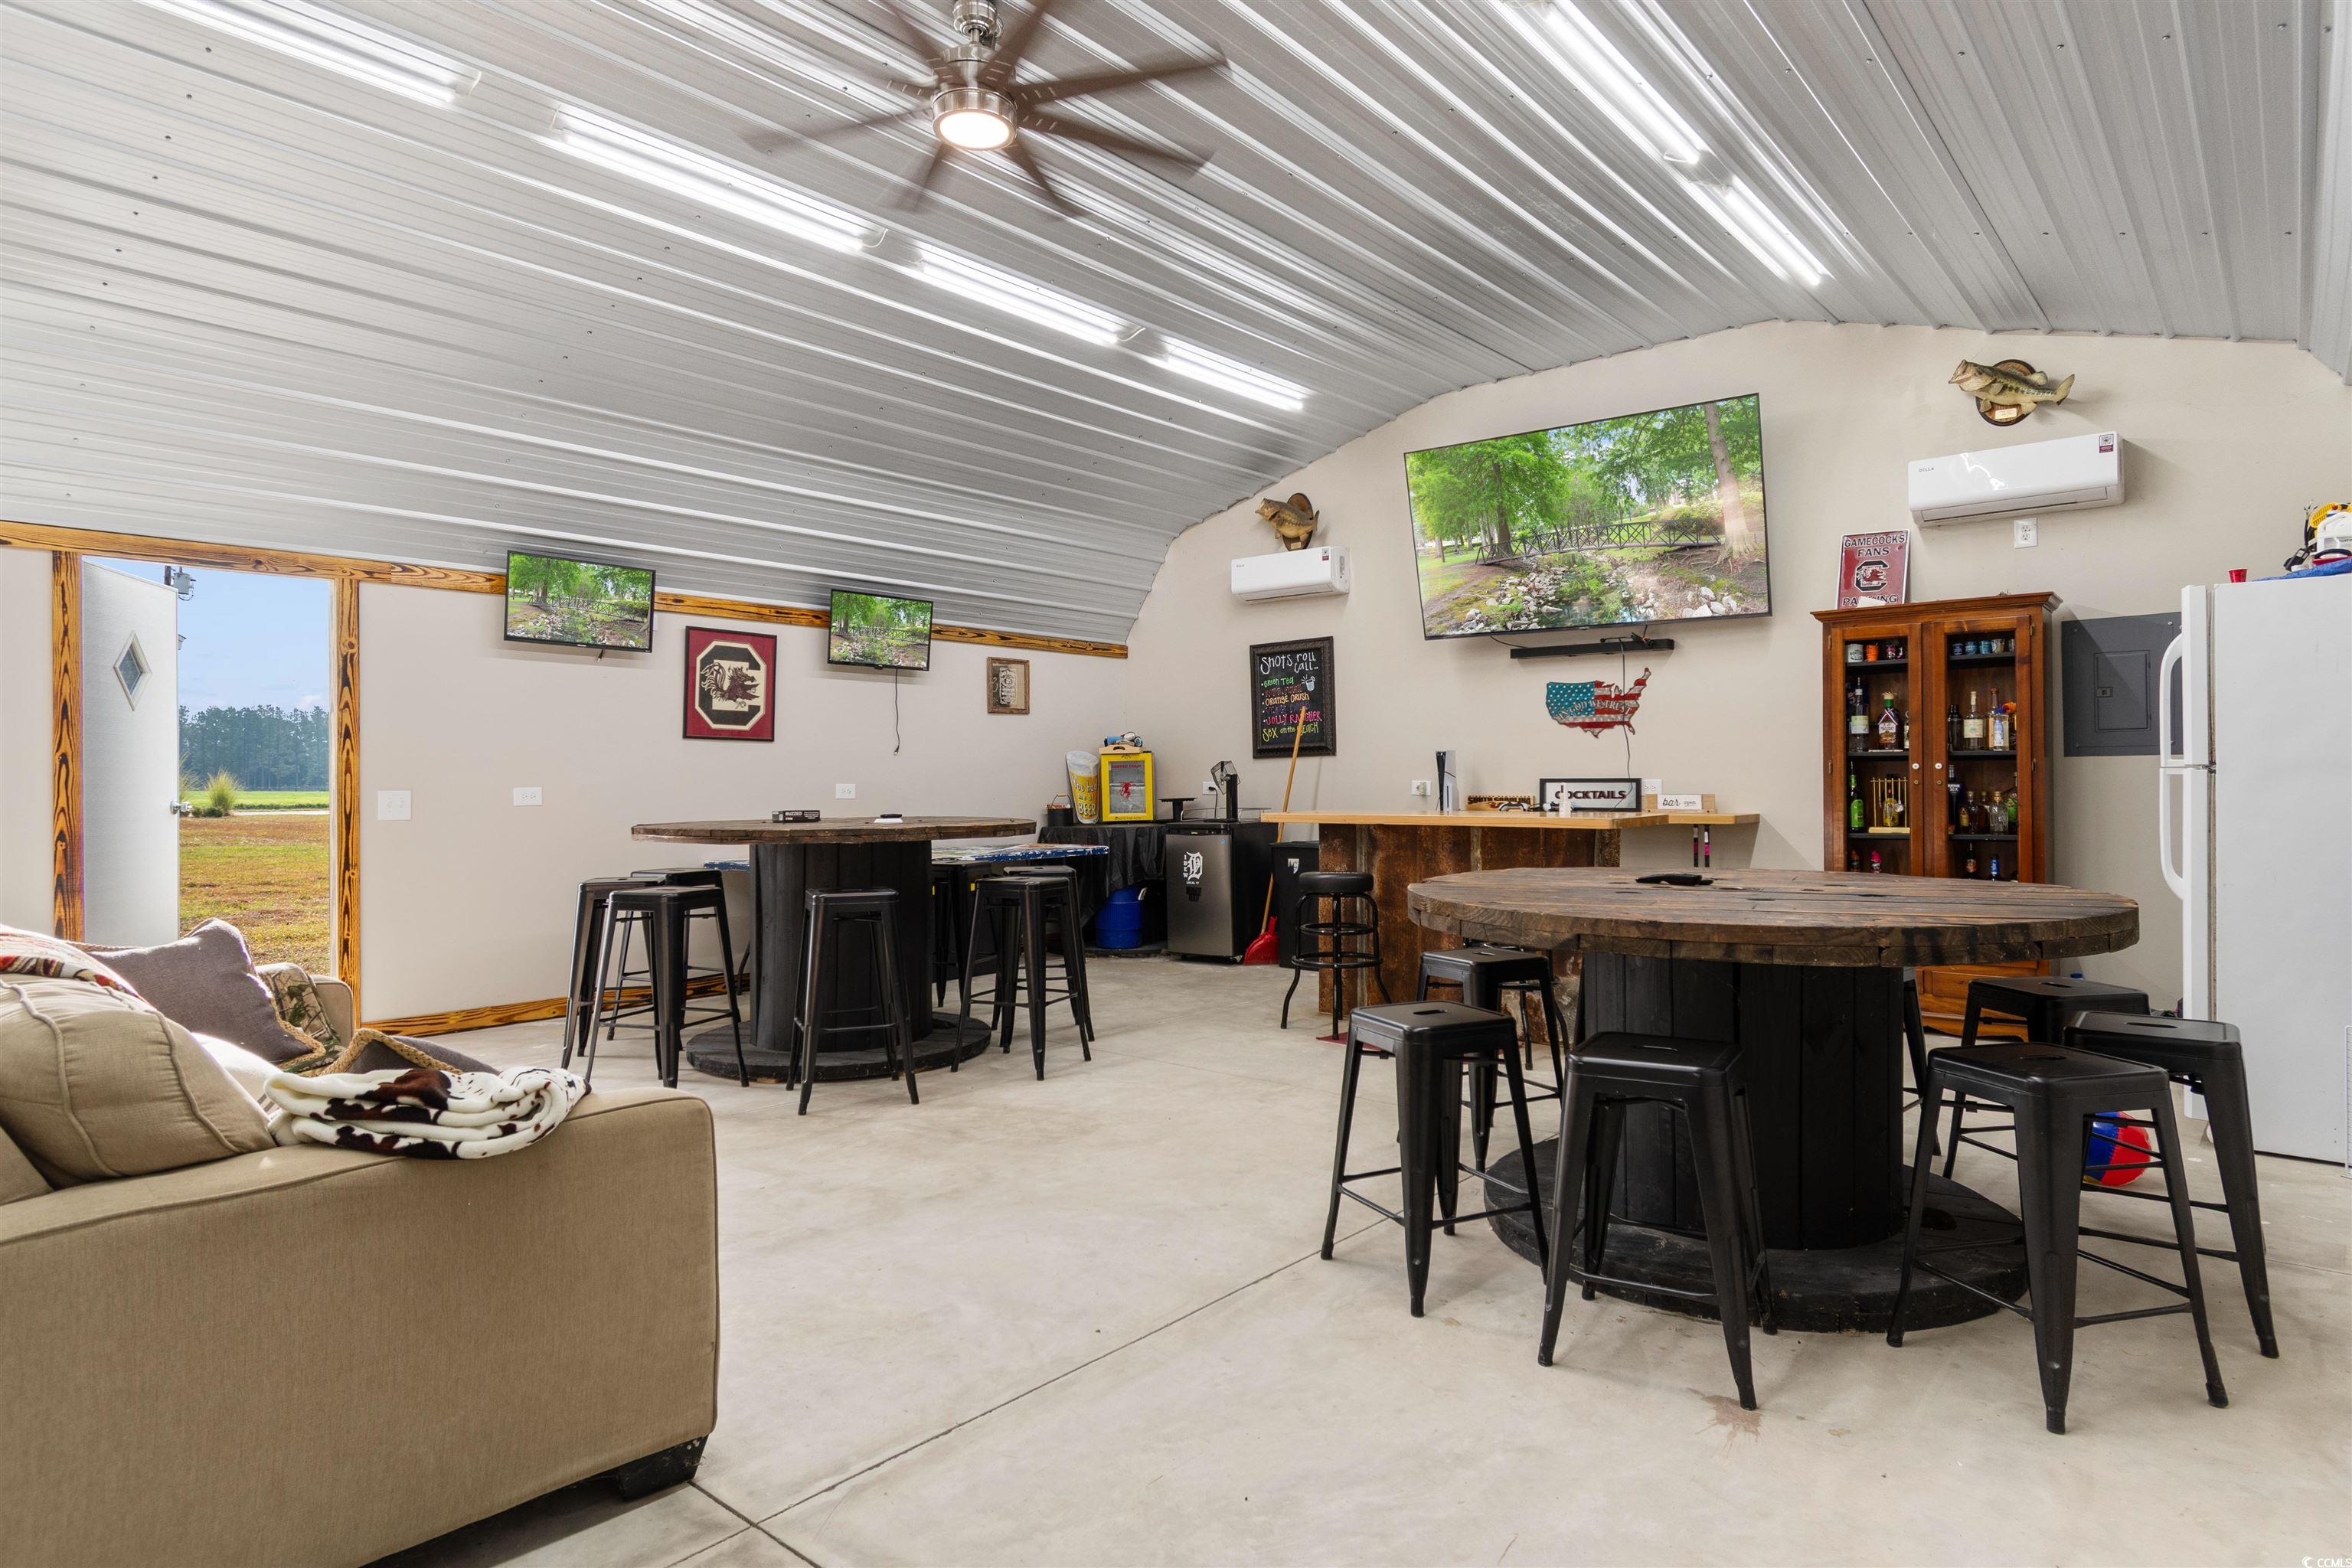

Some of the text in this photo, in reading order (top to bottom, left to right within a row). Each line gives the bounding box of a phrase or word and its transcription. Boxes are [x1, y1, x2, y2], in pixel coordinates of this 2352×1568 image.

[1844, 534, 1905, 547] GAMECOCKS
[1857, 547, 1890, 557] FANS
[1842, 594, 1897, 606] PAING
[1468, 796, 1492, 805] SOUTH
[1662, 798, 1681, 807] bar
[1078, 801, 1096, 816] BEER
